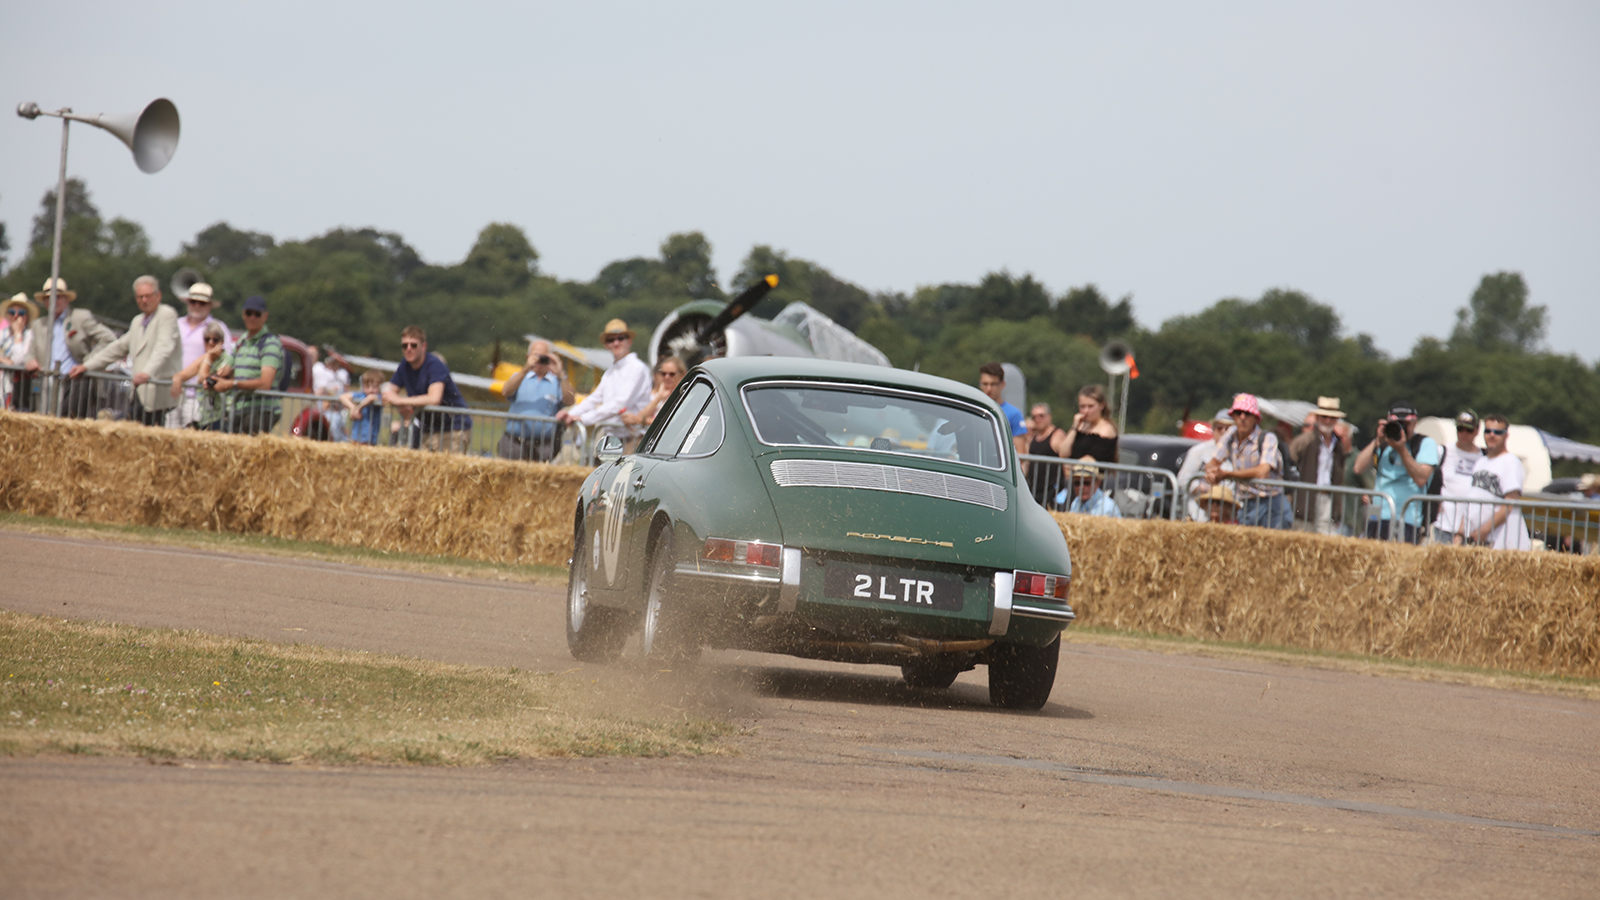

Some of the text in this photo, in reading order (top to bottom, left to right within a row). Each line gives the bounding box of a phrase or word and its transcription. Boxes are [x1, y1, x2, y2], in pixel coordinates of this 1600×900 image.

[846, 531, 954, 548] PORSCHE
[853, 573, 935, 605] 2 LTR
